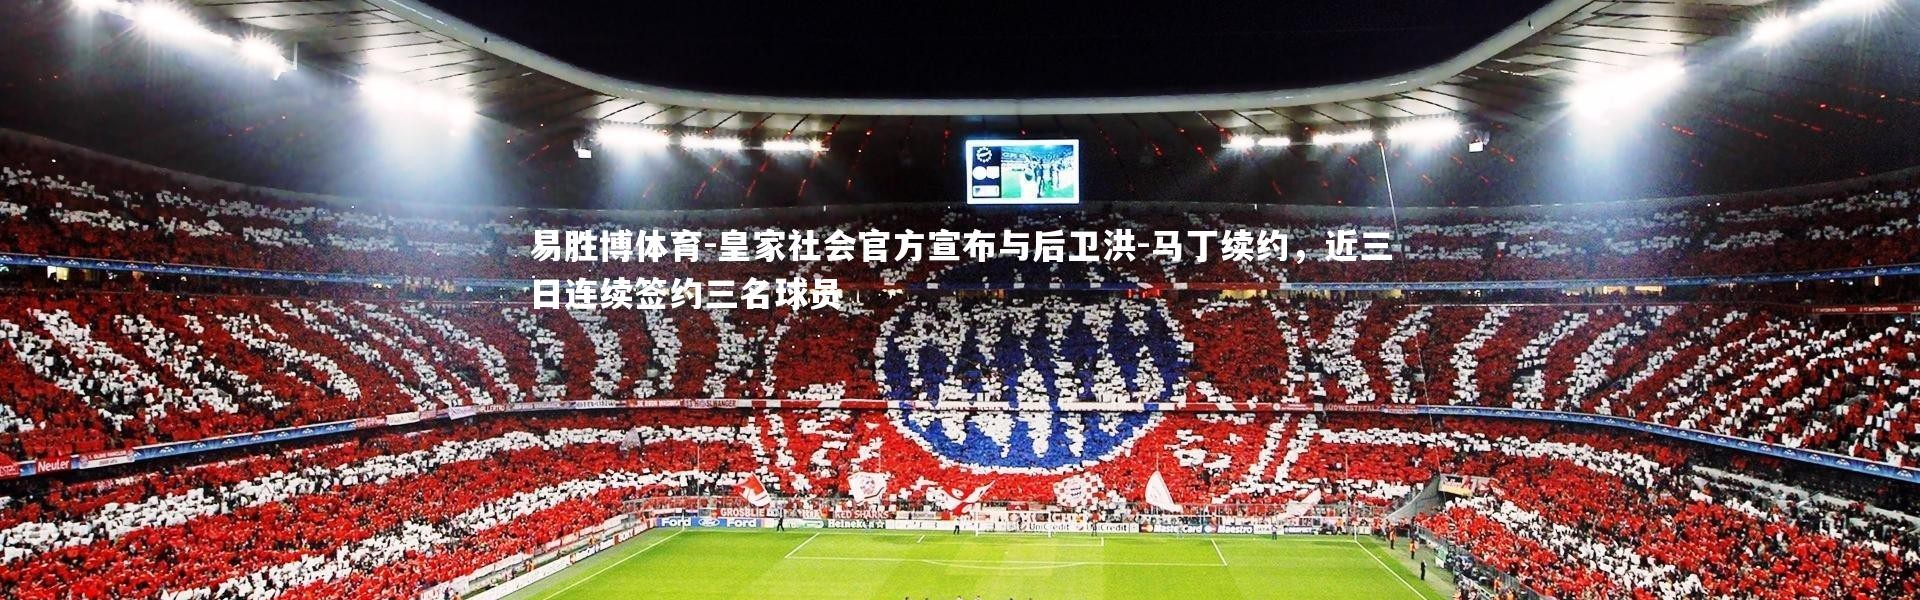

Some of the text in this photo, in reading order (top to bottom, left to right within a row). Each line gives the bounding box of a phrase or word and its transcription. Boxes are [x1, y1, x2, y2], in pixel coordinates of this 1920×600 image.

[661, 517, 692, 526] Ford
[726, 518, 757, 528] Ford
[1086, 522, 1127, 532] UiCredit
